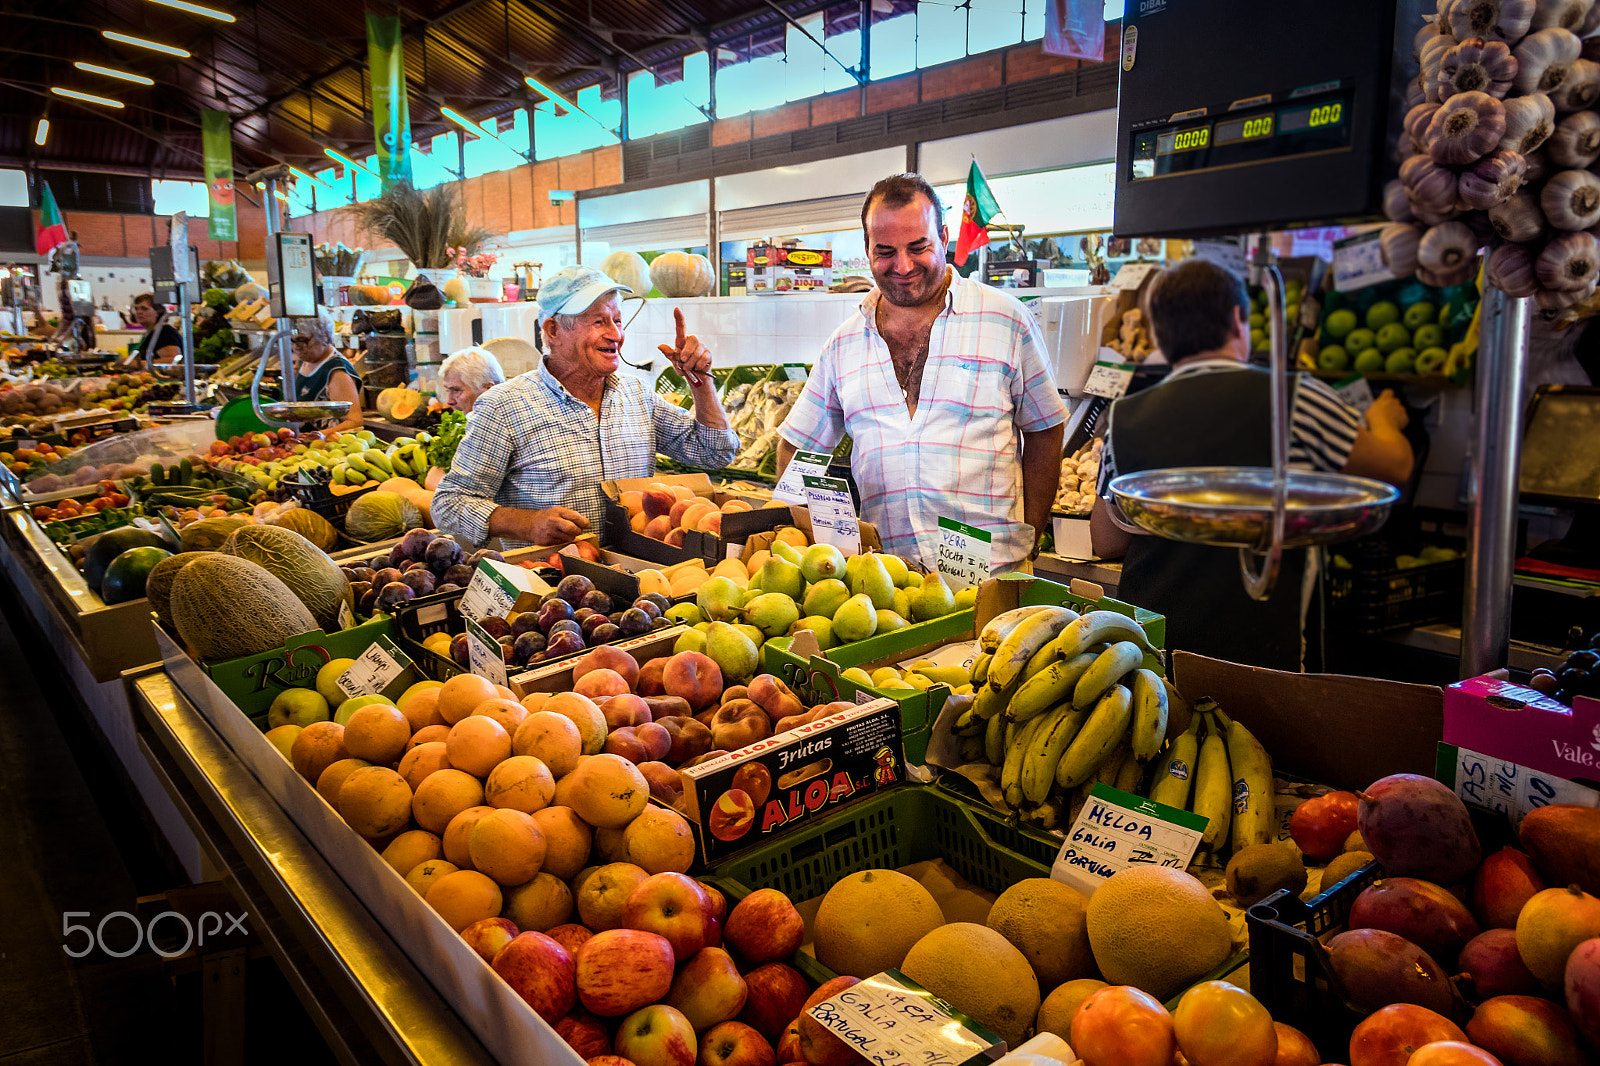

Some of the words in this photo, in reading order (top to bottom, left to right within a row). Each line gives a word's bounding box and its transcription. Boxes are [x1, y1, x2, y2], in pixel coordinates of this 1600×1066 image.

[1309, 103, 1342, 127] 0.00
[1242, 117, 1273, 138] 0.00
[943, 531, 967, 549] PERA
[939, 544, 964, 563] ROCHA
[799, 714, 848, 734] ALOA
[730, 739, 780, 760] ALOA
[778, 737, 832, 769] Frutas
[1552, 739, 1594, 767] Vale
[762, 771, 855, 833] ALOA
[1088, 805, 1152, 840] MELOA
[811, 1002, 877, 1051] PORTUGAL
